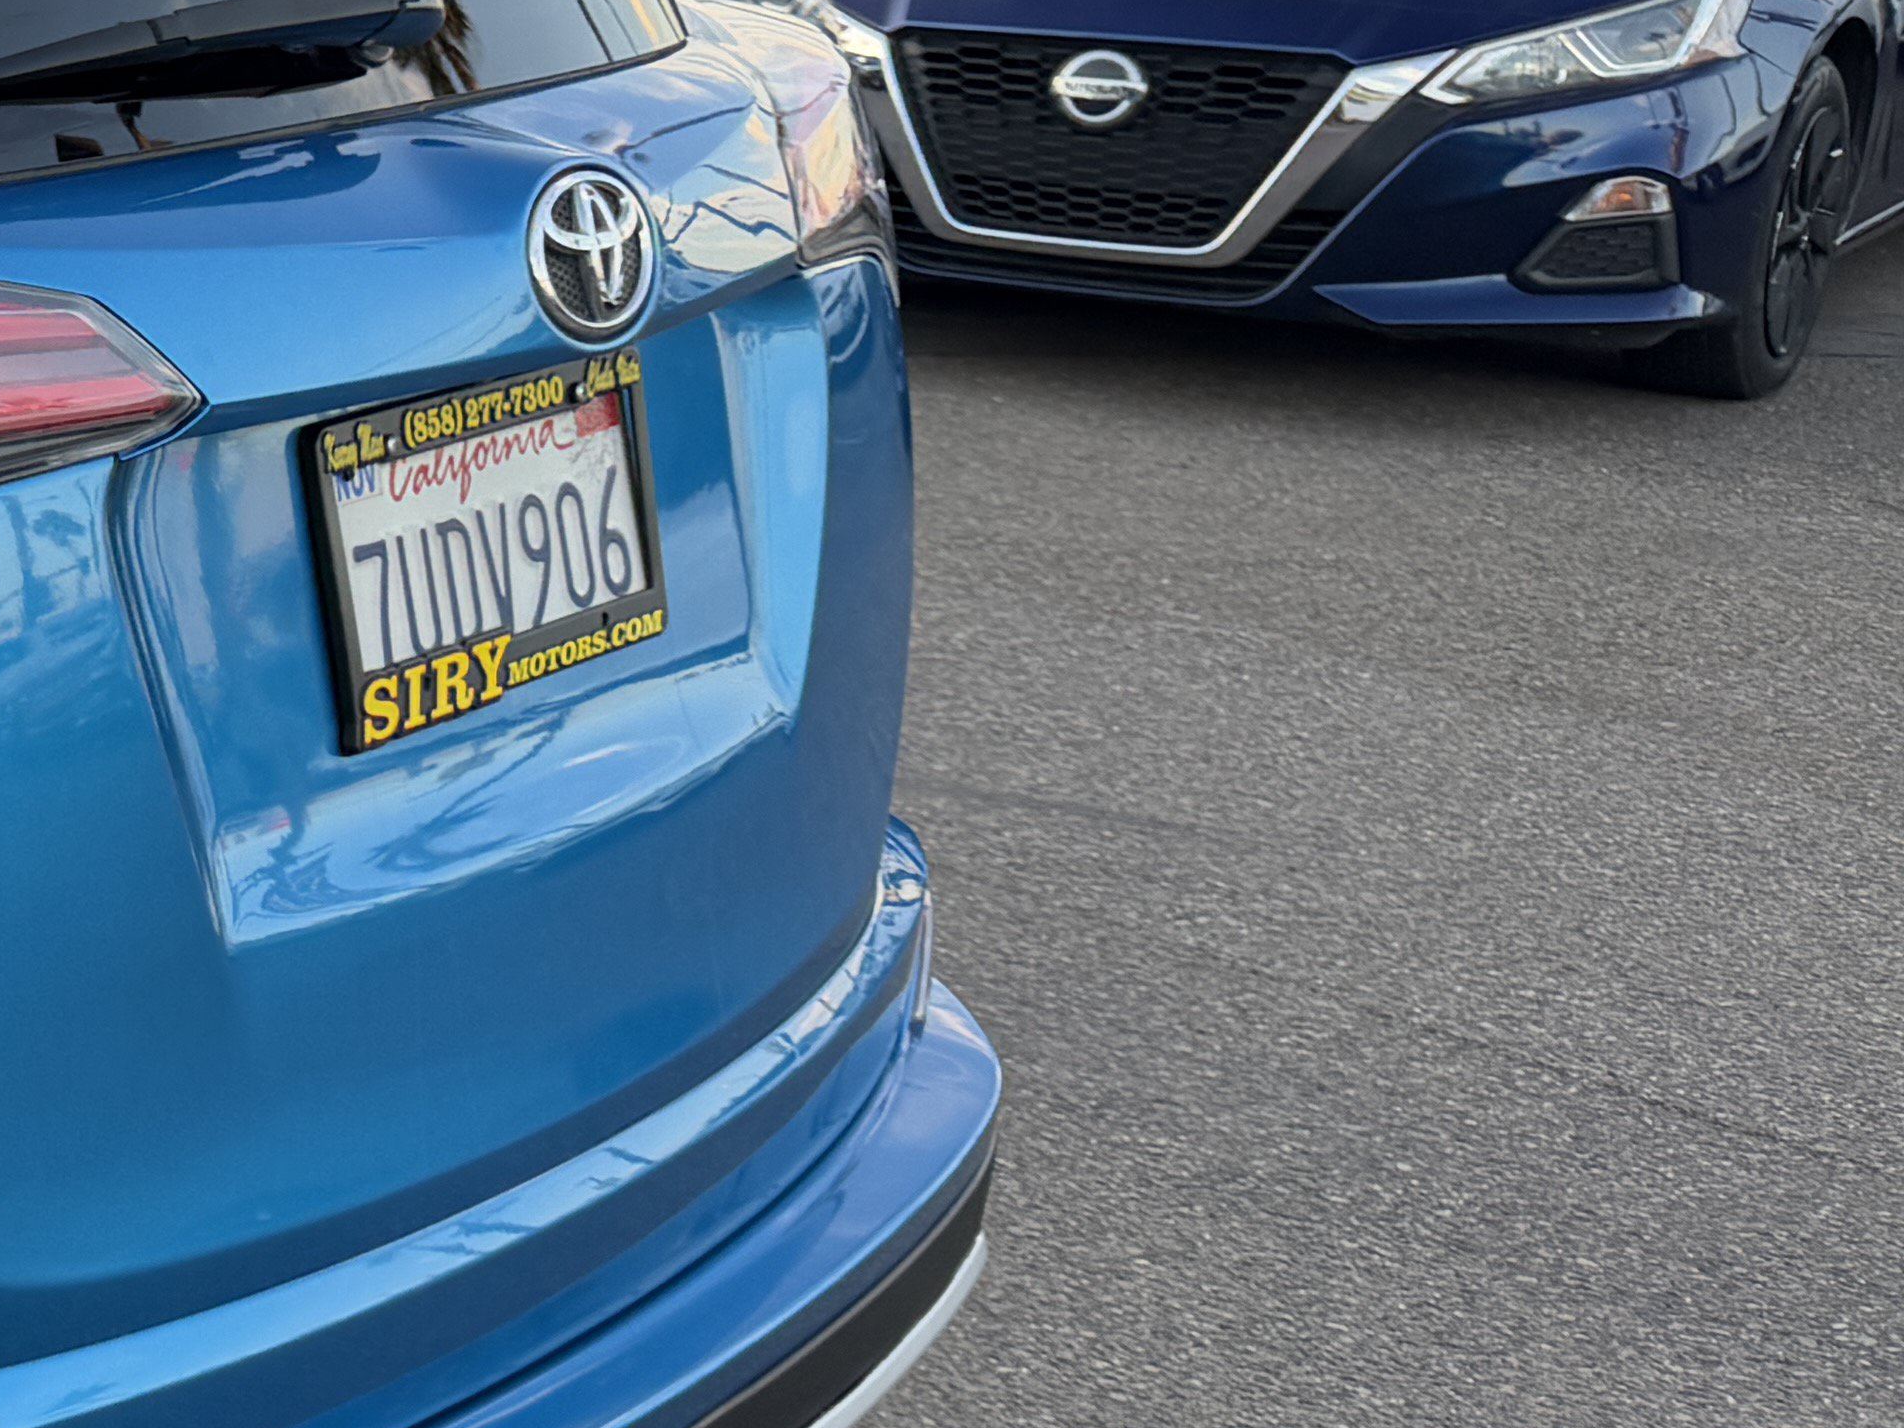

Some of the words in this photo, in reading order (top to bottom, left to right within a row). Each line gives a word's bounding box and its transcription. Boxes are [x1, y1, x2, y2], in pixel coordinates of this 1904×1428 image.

[389, 417, 576, 504] California
[404, 398, 463, 449] (858)
[353, 464, 632, 669] 7UDV906
[363, 634, 512, 744] SIRY
[508, 609, 663, 686] MOTORS.COM
